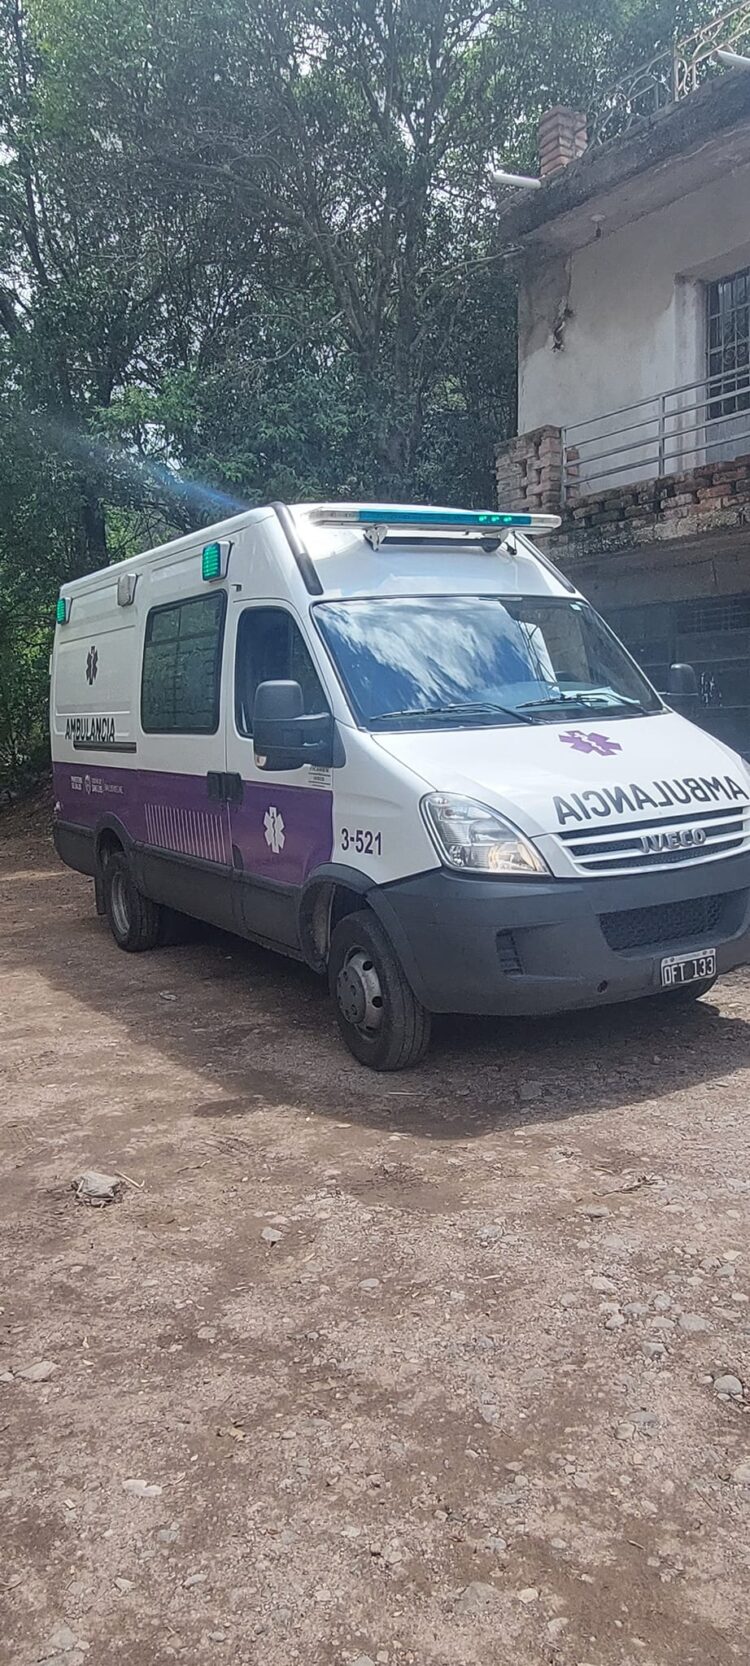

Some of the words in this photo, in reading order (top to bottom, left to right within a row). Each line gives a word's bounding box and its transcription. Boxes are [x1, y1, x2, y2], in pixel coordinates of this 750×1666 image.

[65, 717, 115, 743] AMBULANCIA
[341, 828, 381, 856] 3-521
[640, 828, 706, 853] IVECO
[664, 963, 685, 984] OFT
[692, 957, 713, 977] 133
